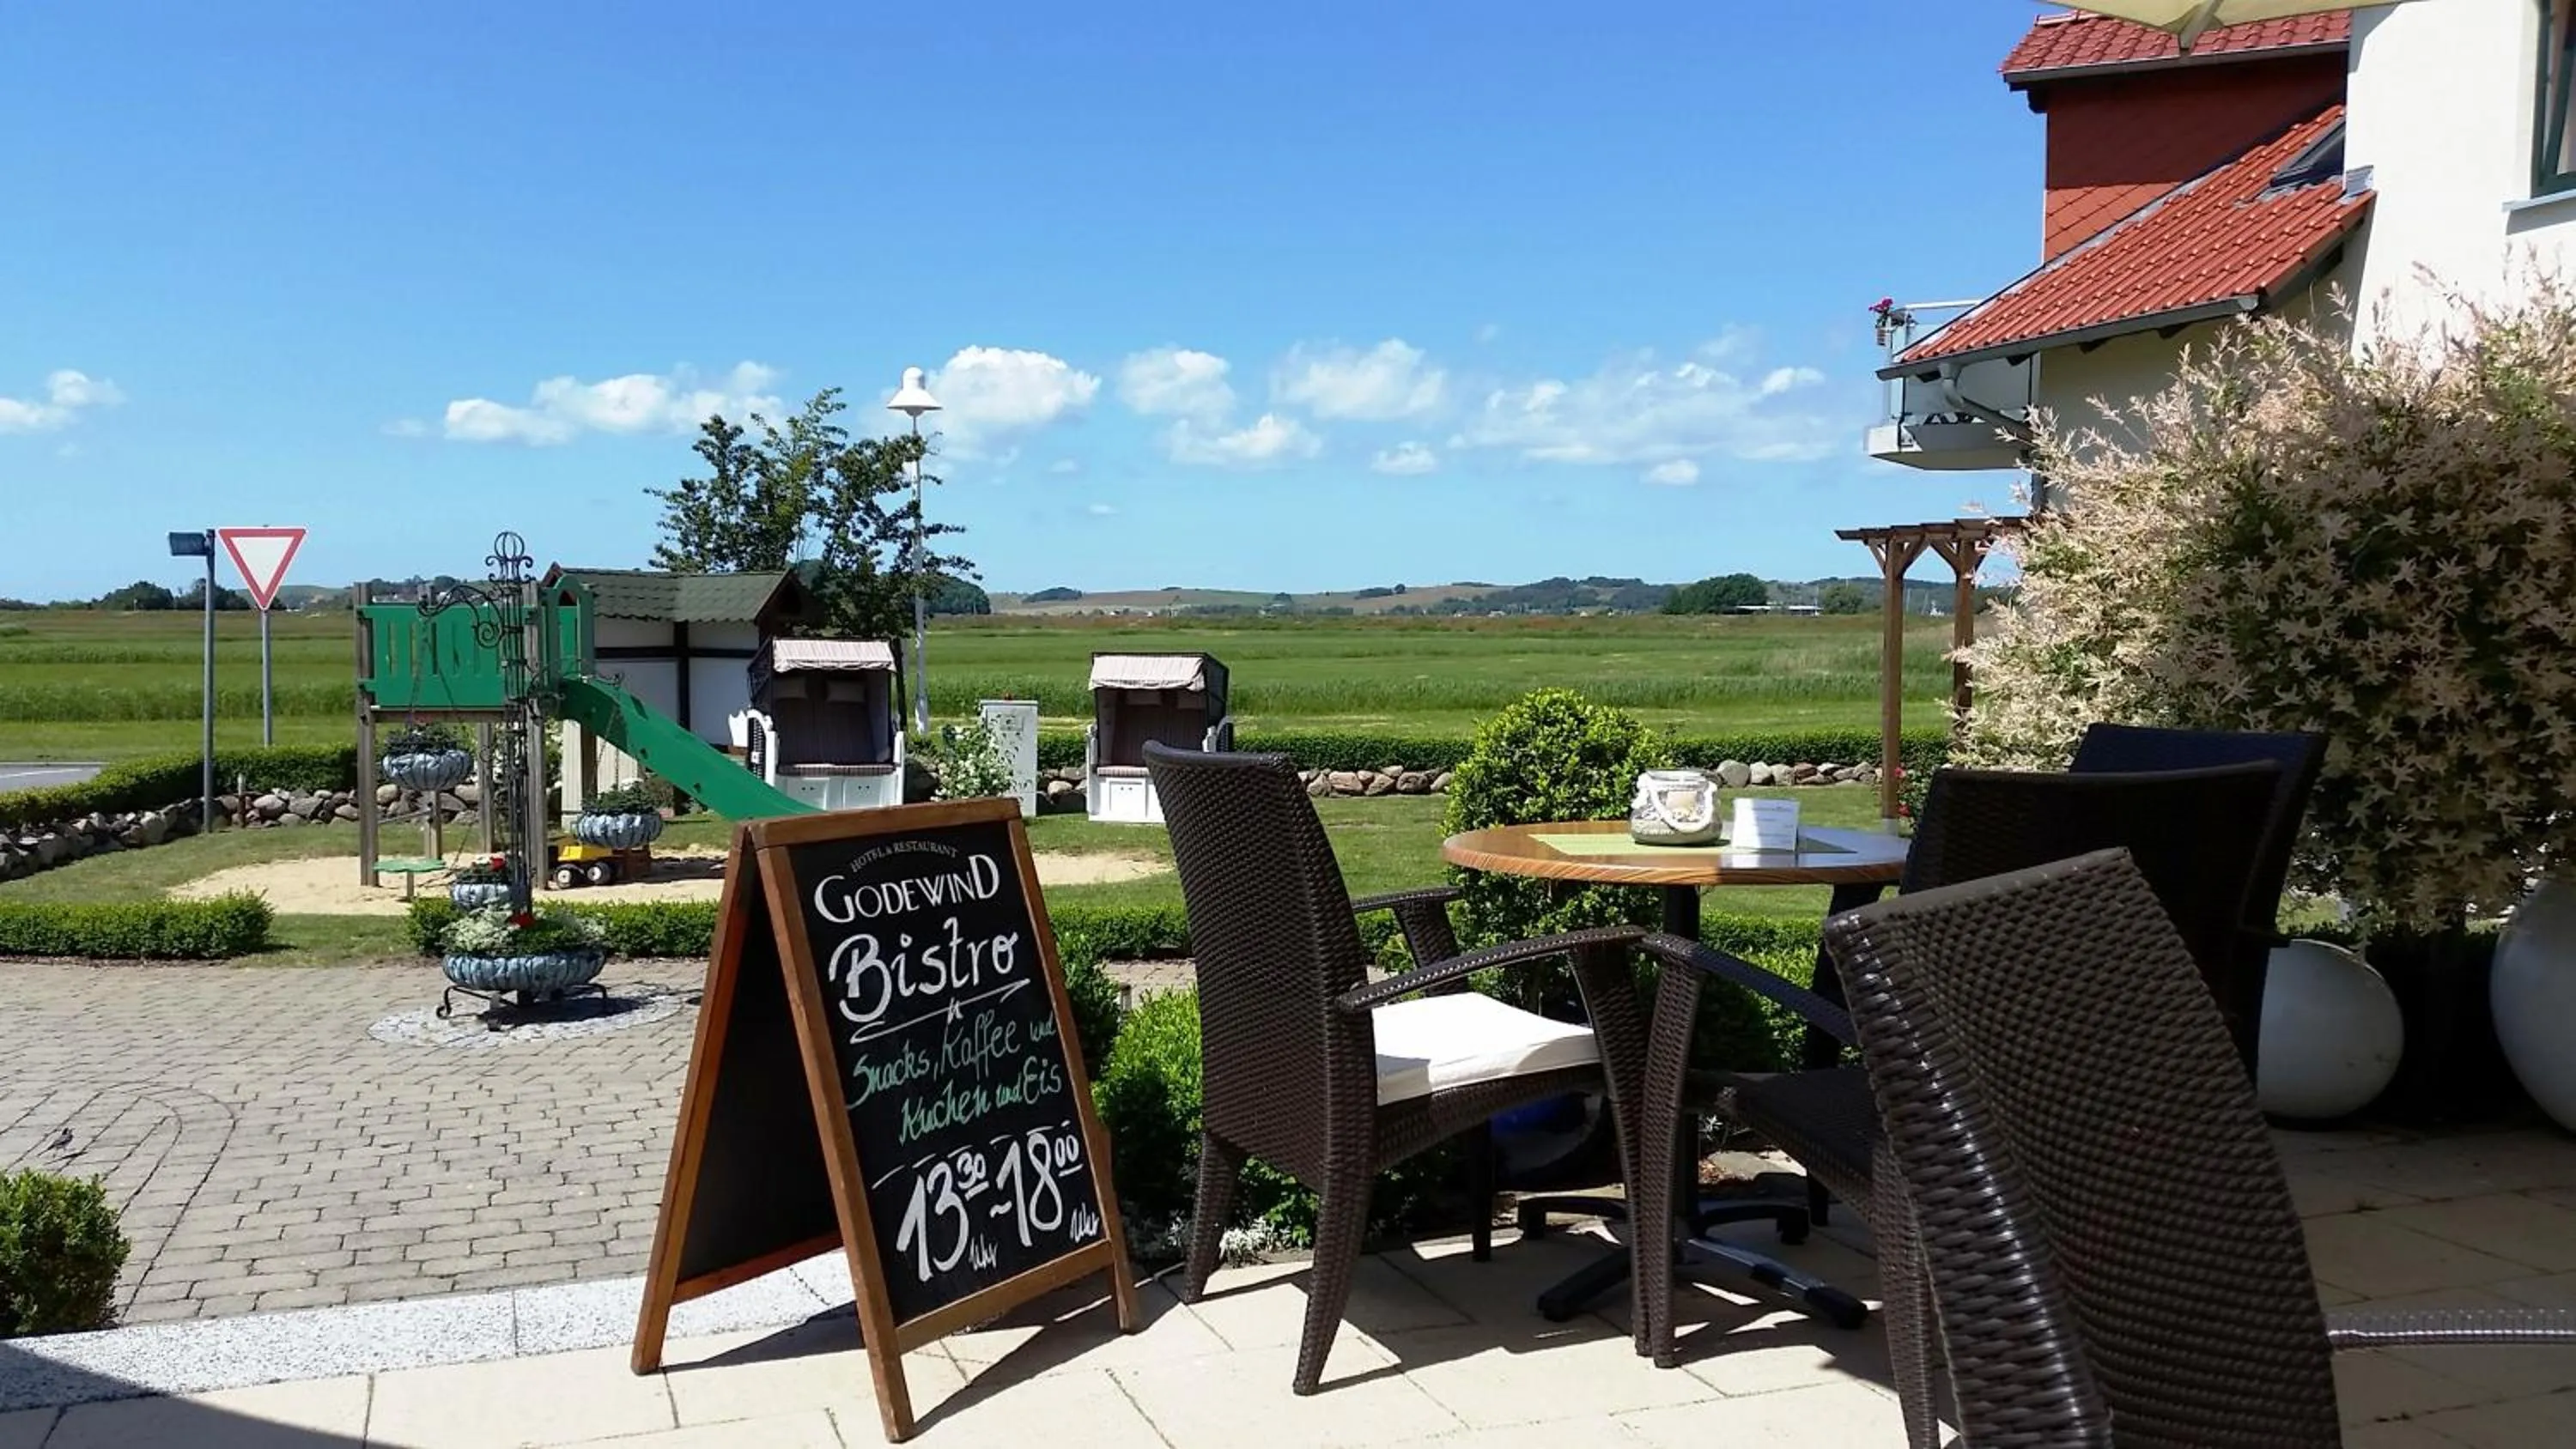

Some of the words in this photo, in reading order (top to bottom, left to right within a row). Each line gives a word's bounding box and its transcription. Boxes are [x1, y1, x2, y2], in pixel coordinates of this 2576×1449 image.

[893, 840, 958, 858] RESTAURANT
[814, 854, 1000, 924] GODEWIND
[828, 917, 1019, 1023] Bistro
[941, 1009, 1021, 1081] Kaffee
[899, 1079, 992, 1146] Kuchen
[995, 1073, 1023, 1109] und
[1023, 1056, 1062, 1105] Eis
